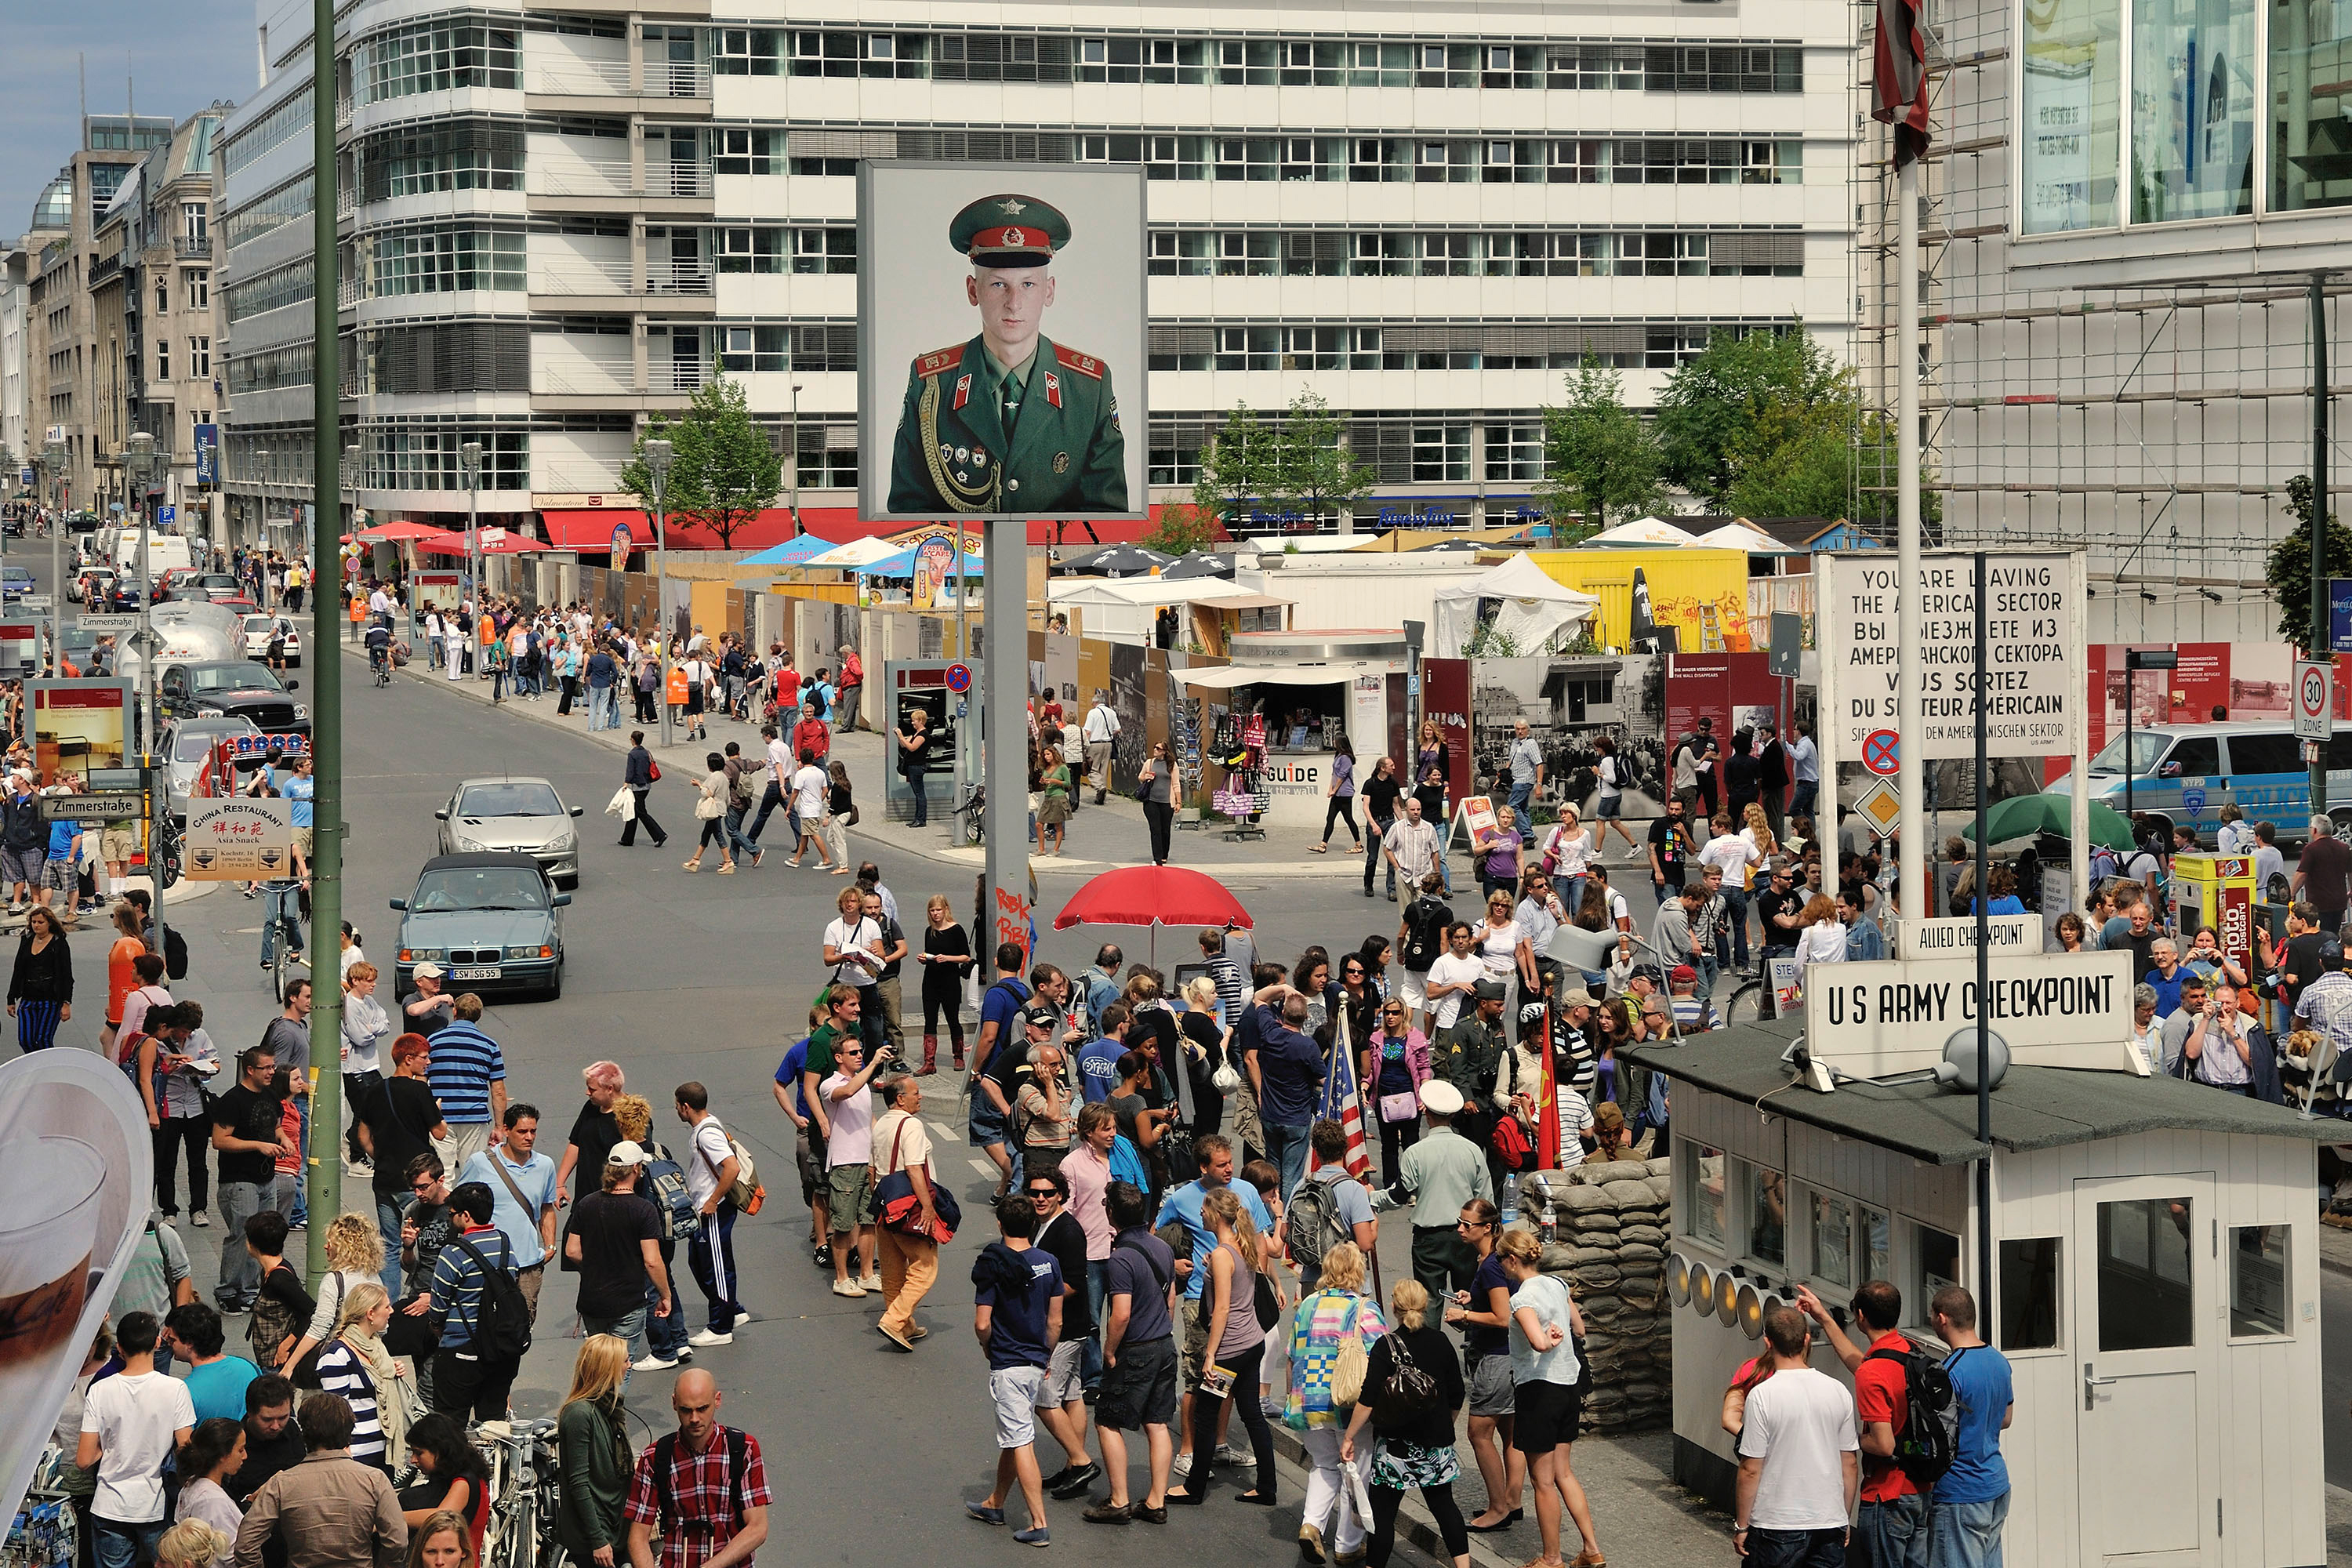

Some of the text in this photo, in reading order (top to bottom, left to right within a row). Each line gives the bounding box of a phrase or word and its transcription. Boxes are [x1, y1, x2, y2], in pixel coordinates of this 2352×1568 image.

[534, 495, 585, 506] Valmontone
[1372, 506, 1455, 529] Fitness First
[1969, 568, 2051, 587] LAVING
[1852, 593, 2063, 614] THE ERICA SECTOR
[83, 617, 132, 628] Zimmerstraße
[1854, 622, 1886, 641] ВЫ
[2032, 619, 2057, 638] ИЗ
[1994, 644, 2063, 663] СЕКТОРА
[1886, 672, 1942, 691] VUS
[2306, 681, 2321, 703] 30
[1852, 699, 1875, 717] DU
[1883, 697, 1962, 717] STEUR
[1926, 726, 1944, 739] DEN
[2029, 723, 2063, 737] SEKTOR
[2303, 718, 2322, 733] ZONE
[1276, 786, 1290, 795] the
[1294, 786, 1318, 796] wall
[2182, 778, 2205, 787] NYPD
[53, 798, 132, 813] Zimmerstraße
[2235, 786, 2310, 815] POLICE
[193, 804, 283, 828] CHINA RESTAURANT
[2045, 895, 2066, 904] CHECKPOINT
[2237, 902, 2249, 951] postcard
[1919, 924, 2024, 949] ALLIED CHEKPOINT
[486, 969, 495, 978] 55
[1828, 975, 2114, 1025] U S ARMY CHECKPOINT
